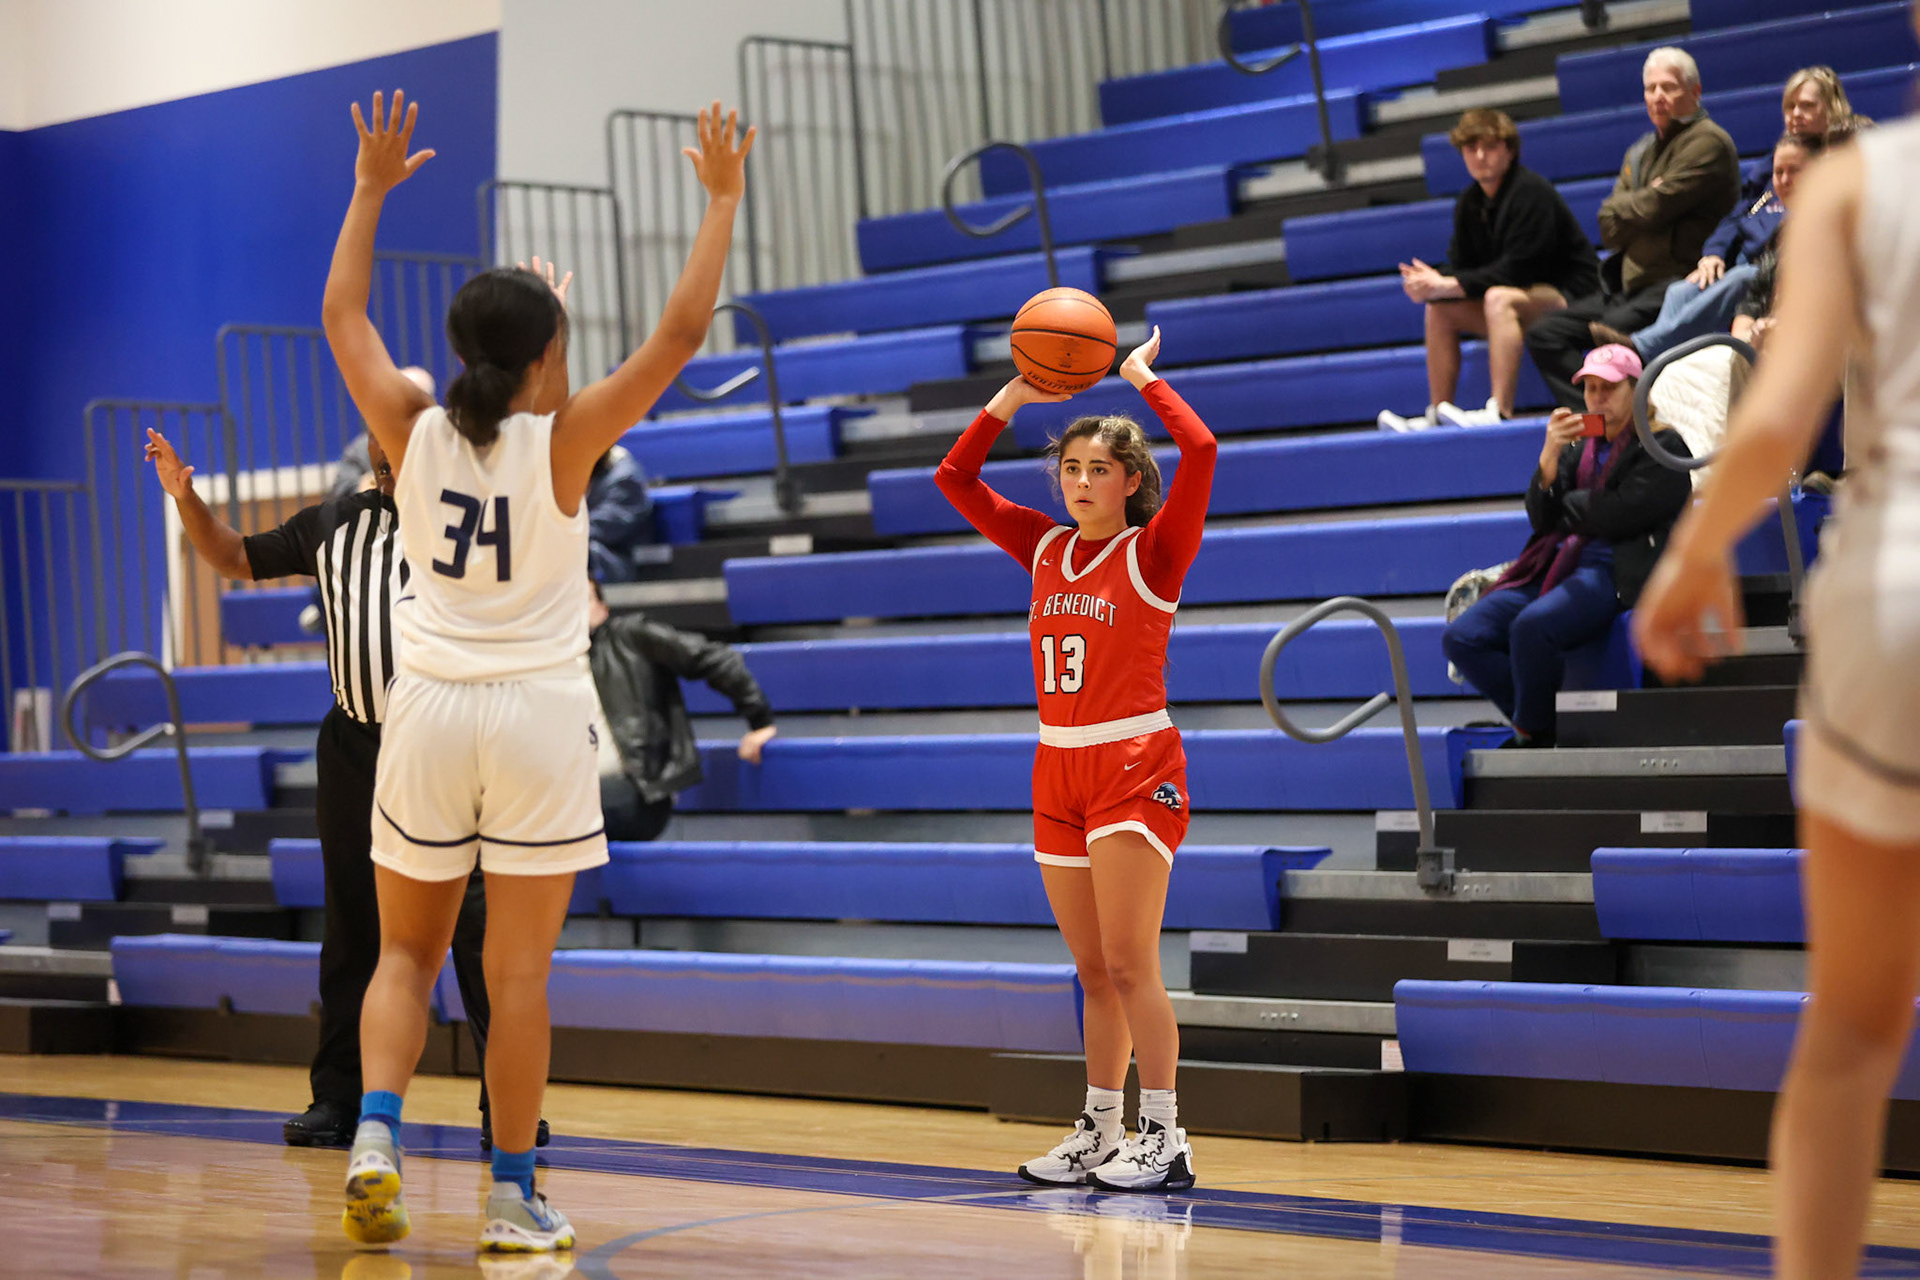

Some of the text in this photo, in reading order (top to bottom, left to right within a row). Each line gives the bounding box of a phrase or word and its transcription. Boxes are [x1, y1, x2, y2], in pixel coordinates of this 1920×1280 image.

[432, 488, 511, 582] 34
[1028, 592, 1117, 627] T. BENEDICT
[1040, 633, 1087, 694] 13
